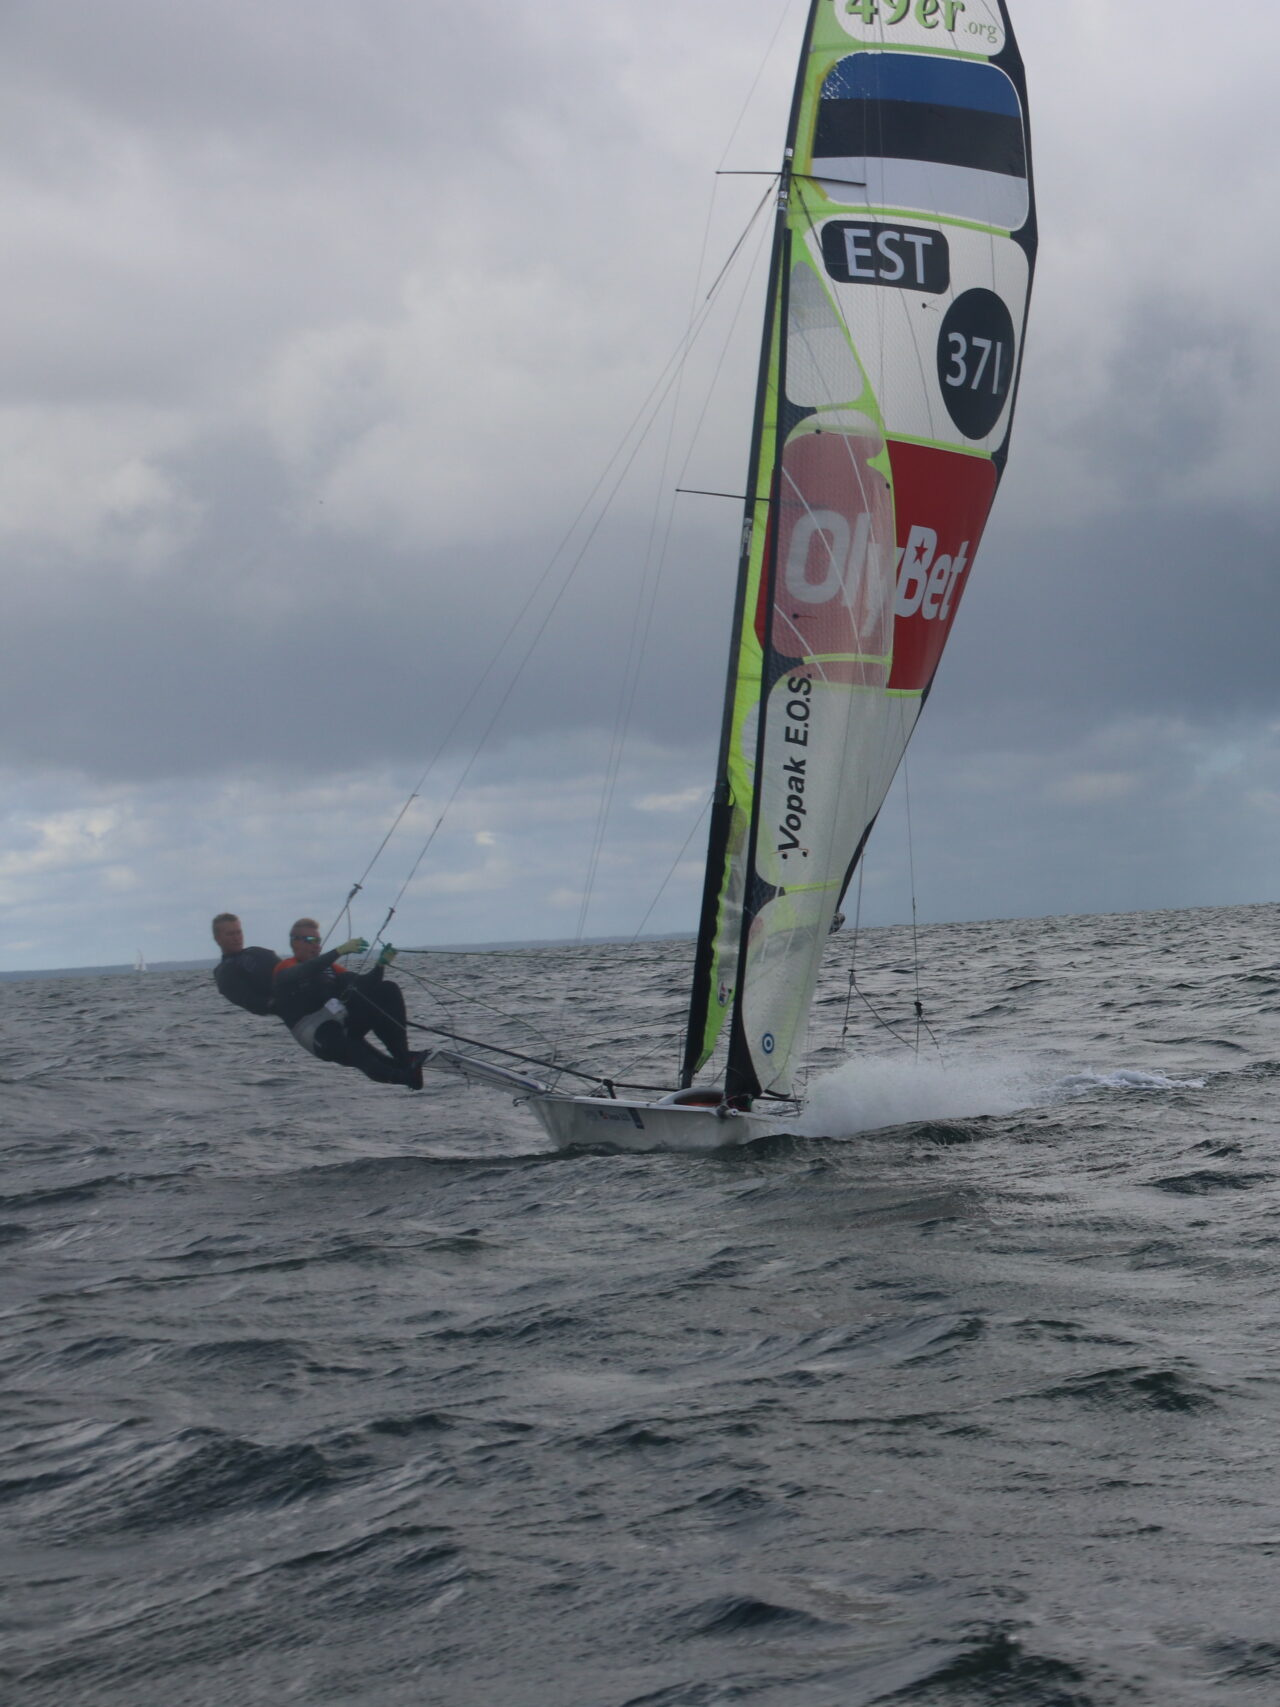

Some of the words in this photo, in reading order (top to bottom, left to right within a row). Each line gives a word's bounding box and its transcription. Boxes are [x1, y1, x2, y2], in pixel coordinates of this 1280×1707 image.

[843, 228, 933, 284] EST
[945, 332, 1002, 395] 371
[785, 510, 969, 637] OlyBet
[785, 673, 812, 747] E.O.S.
[778, 756, 807, 850] Vopak
